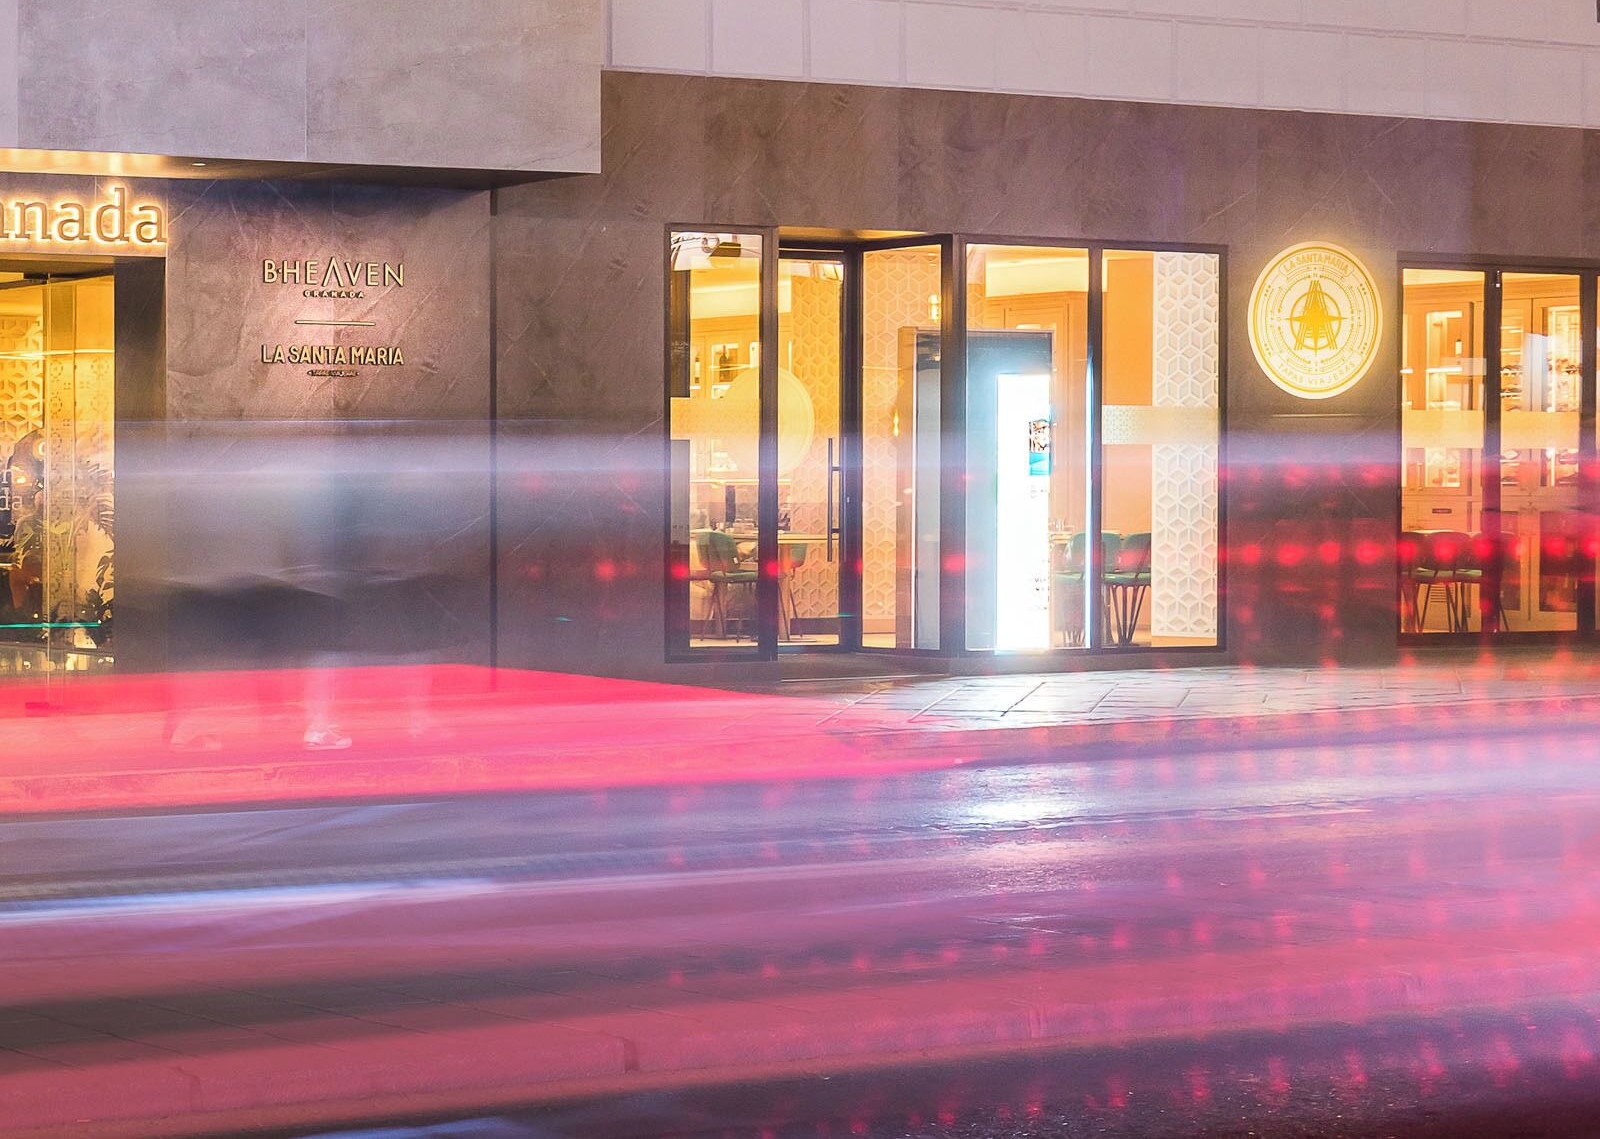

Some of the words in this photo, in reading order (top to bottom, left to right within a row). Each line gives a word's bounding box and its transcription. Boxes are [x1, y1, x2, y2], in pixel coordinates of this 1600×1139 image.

[303, 289, 365, 299] GRANADA
[261, 344, 286, 364] LA
[288, 344, 347, 365] SANTA
[350, 345, 405, 366] MARIA
